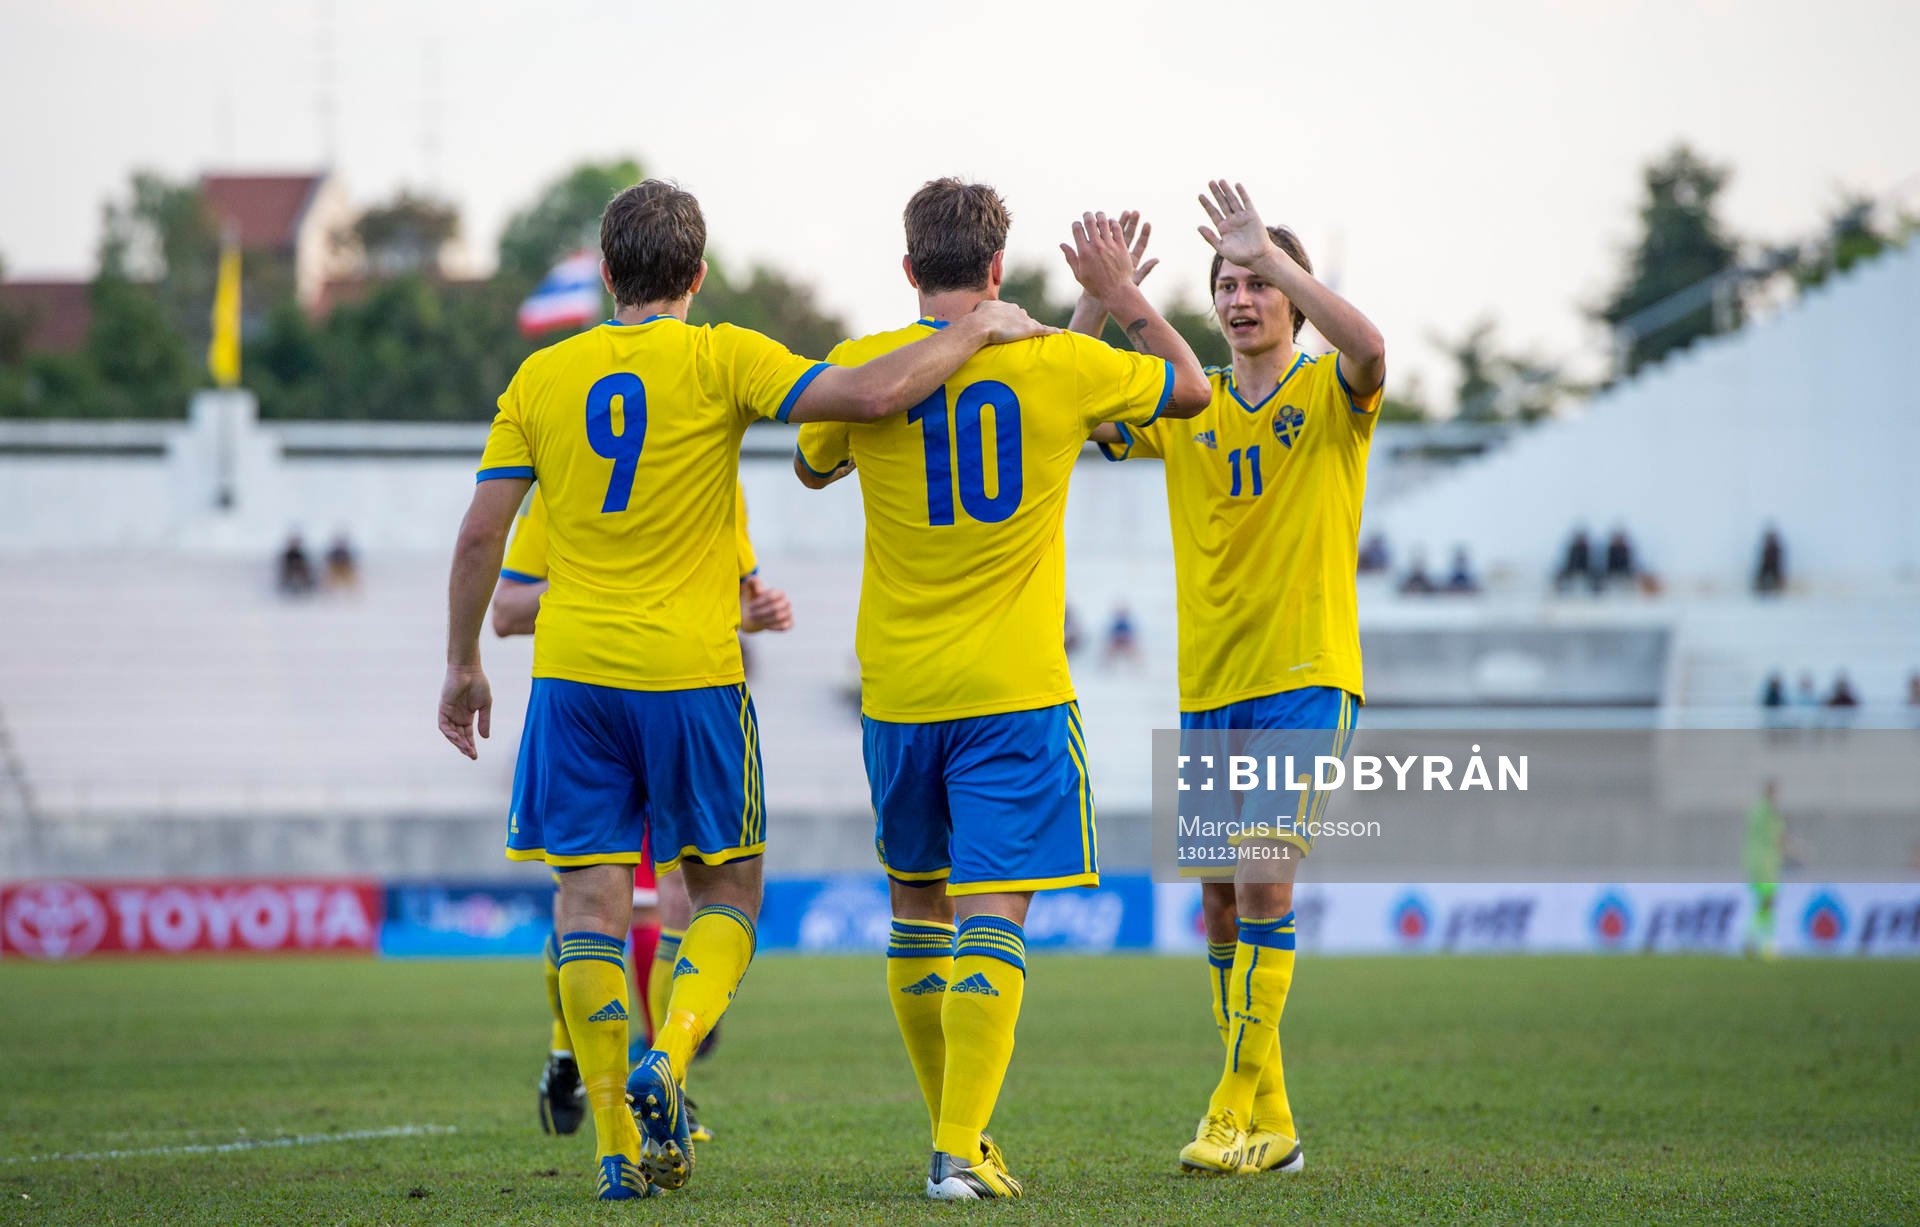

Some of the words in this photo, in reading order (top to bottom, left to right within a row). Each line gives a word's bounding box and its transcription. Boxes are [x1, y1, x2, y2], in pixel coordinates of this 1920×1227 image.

[586, 372, 647, 513] 9
[908, 380, 1023, 527] 10
[1228, 445, 1262, 496] 11
[111, 887, 373, 950] TOYOTA
[900, 983, 946, 996] adida
[951, 984, 999, 997] adidas
[588, 1013, 628, 1022] adida
